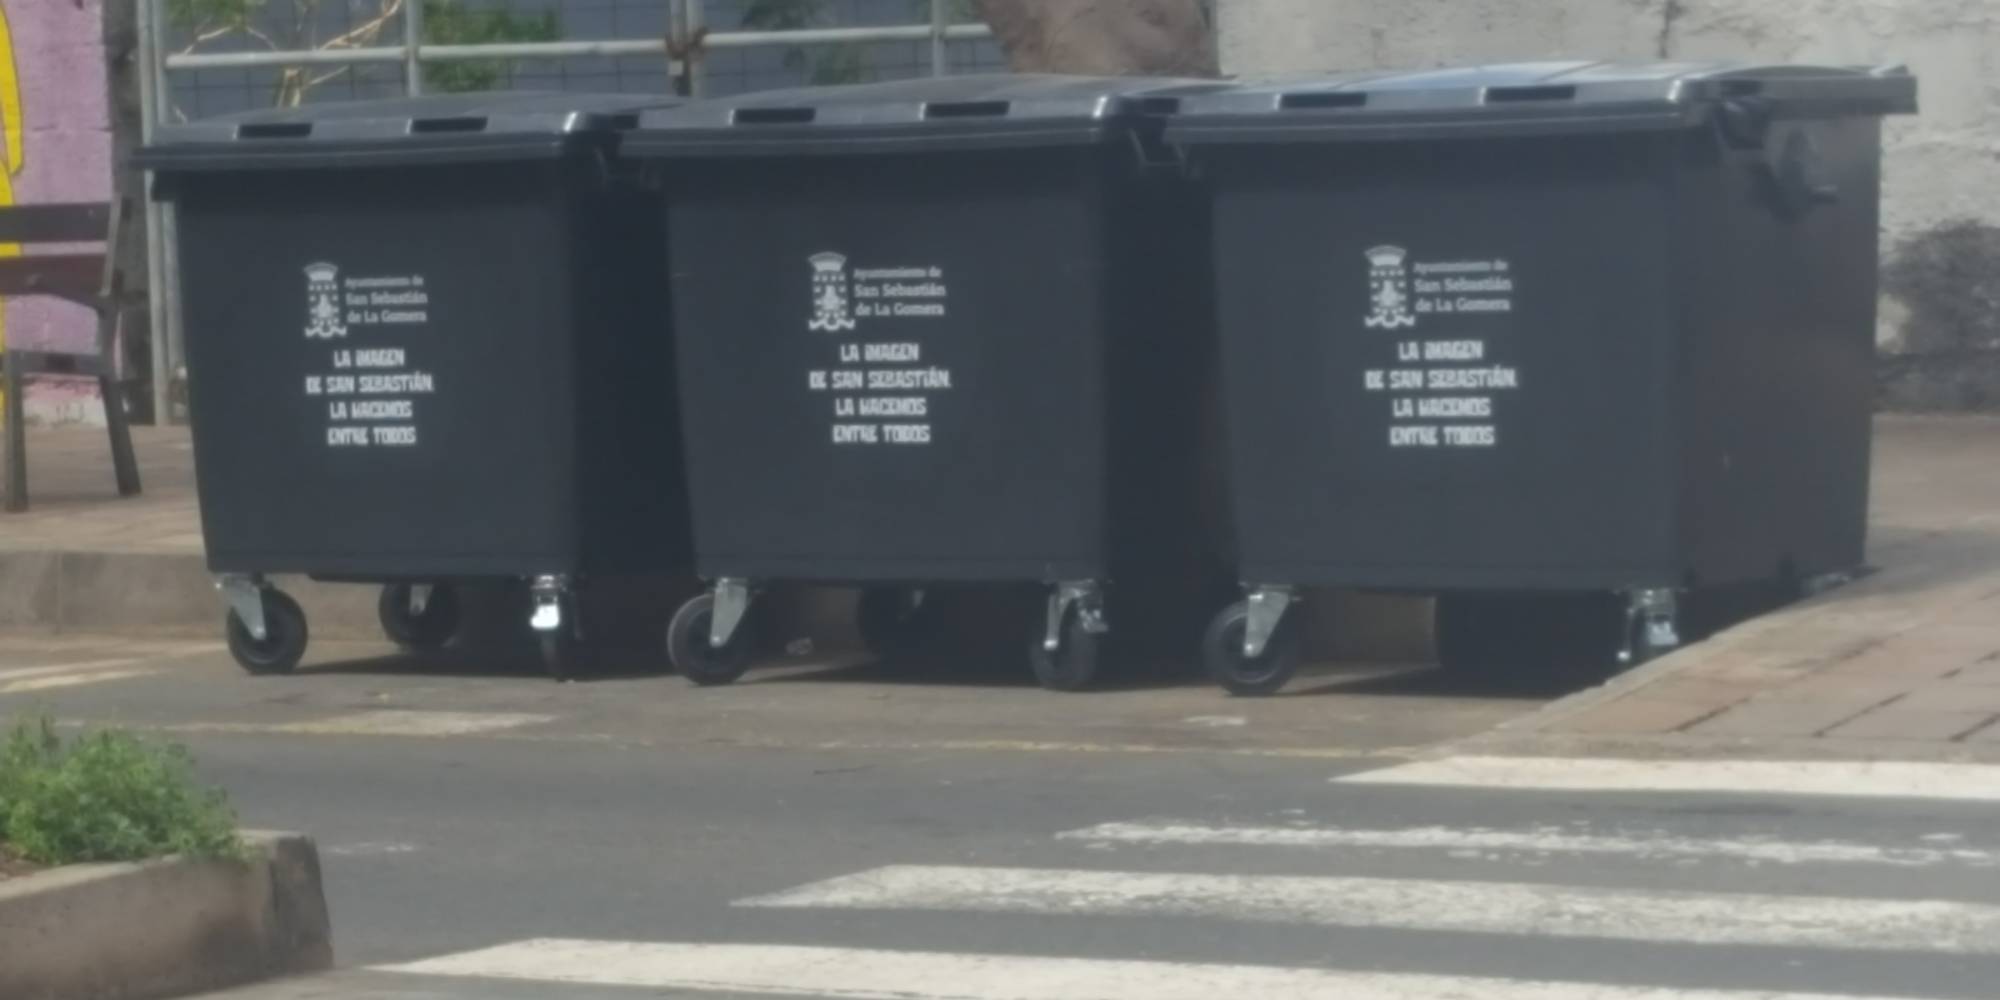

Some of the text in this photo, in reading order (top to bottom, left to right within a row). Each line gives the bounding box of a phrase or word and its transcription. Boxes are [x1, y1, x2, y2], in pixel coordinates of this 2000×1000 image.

[929, 266, 942, 278] de
[1493, 259, 1508, 271] de
[412, 276, 423, 286] de
[854, 282, 946, 297] San Sebastián
[1414, 277, 1512, 293] San Sebastián
[345, 291, 427, 305] San Sebastián
[1416, 297, 1511, 312] de La Gomera
[347, 309, 427, 323] de La Gomera
[855, 302, 944, 316] de La Gomera
[334, 348, 405, 368] LA IMAGEN
[840, 343, 919, 362] LA IMAGEN
[1399, 340, 1484, 361] LA IMAGEN
[306, 375, 322, 394] DE
[326, 375, 355, 393] SAN
[809, 370, 827, 389] DE
[832, 370, 863, 389] SAN
[1365, 369, 1384, 389] DE
[1389, 369, 1424, 389] SAN
[330, 400, 413, 420] LA HACEMOS
[835, 397, 927, 416] LA HACEMOS
[1393, 397, 1491, 417] LA HACEMOS
[327, 426, 416, 446] ENTRE TODOS
[832, 424, 931, 443] ENTRE TODOS
[1390, 425, 1495, 446] ENTRE TODOS
